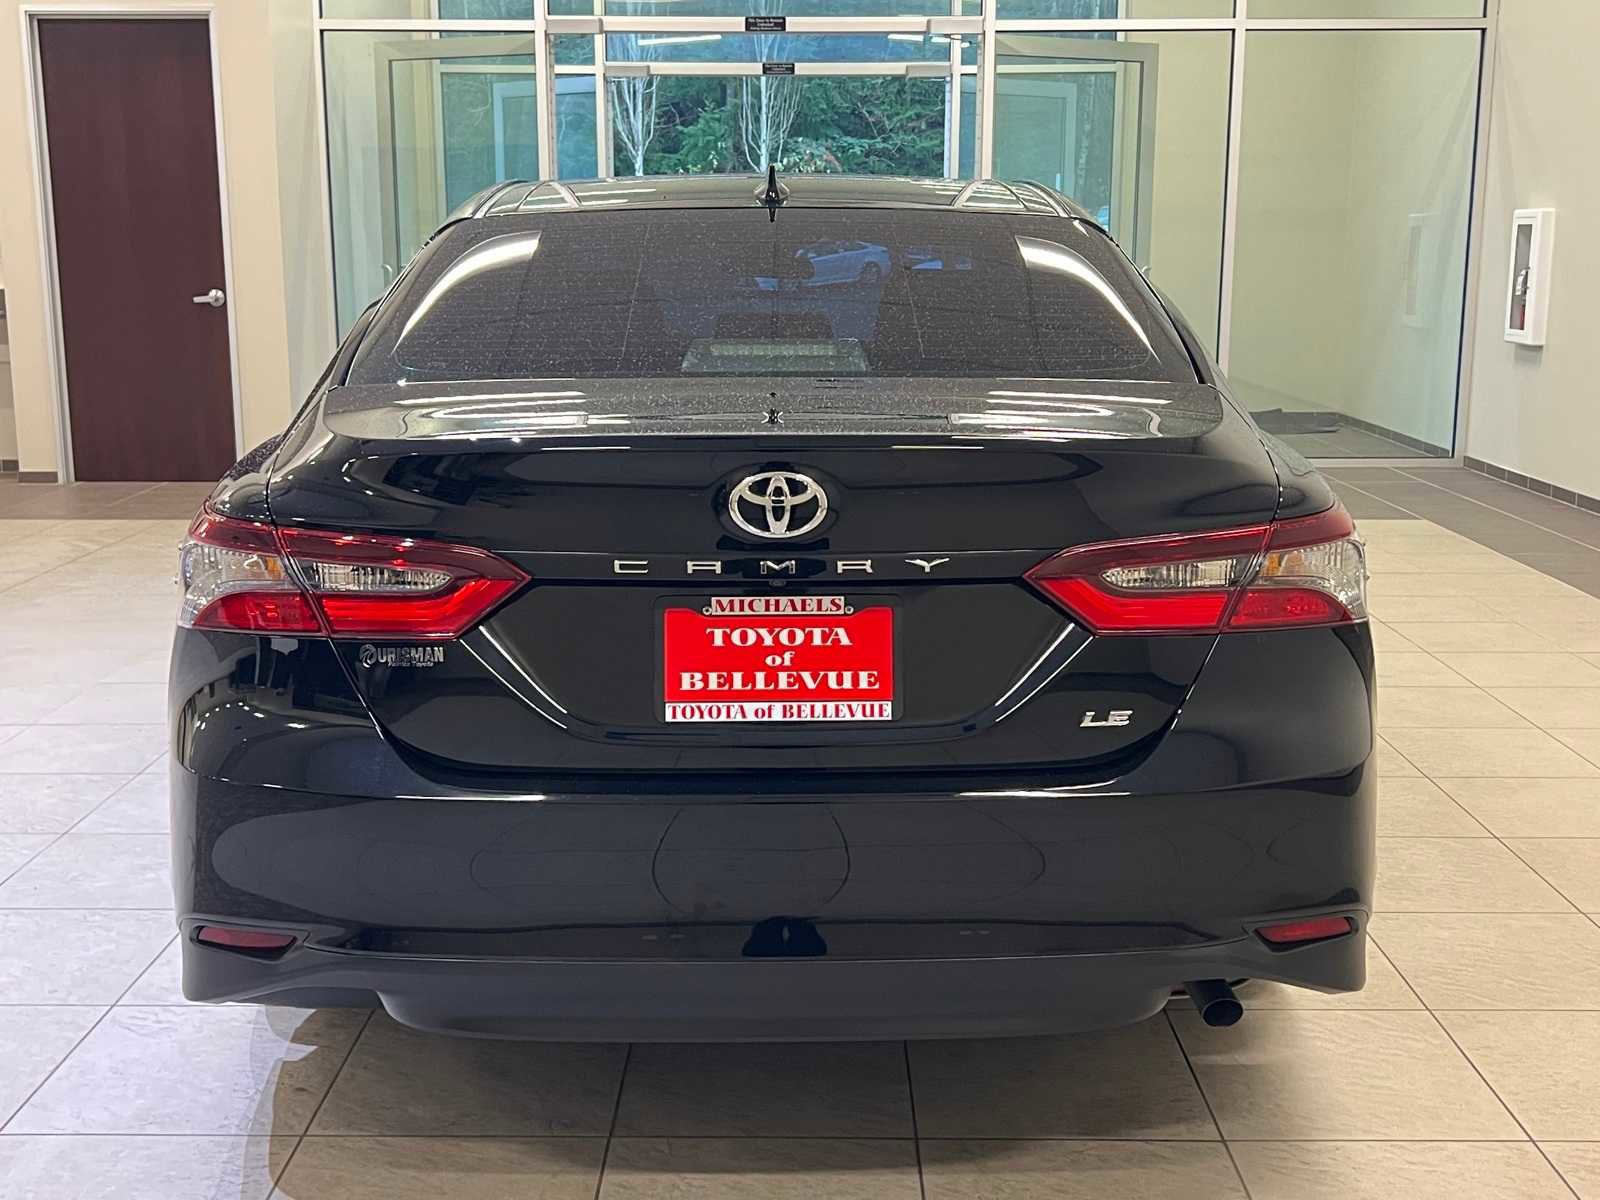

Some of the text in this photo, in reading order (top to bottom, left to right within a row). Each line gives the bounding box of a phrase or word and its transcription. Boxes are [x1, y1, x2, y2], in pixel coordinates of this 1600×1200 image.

[613, 557, 950, 575] CAMRY
[714, 598, 842, 613] MICHAELS
[706, 627, 853, 647] TOYOTA
[764, 651, 796, 667] of
[679, 671, 880, 691] BELLEVUE
[667, 702, 890, 720] TOYOTA of BELLEVUE
[1079, 709, 1134, 728] LE
